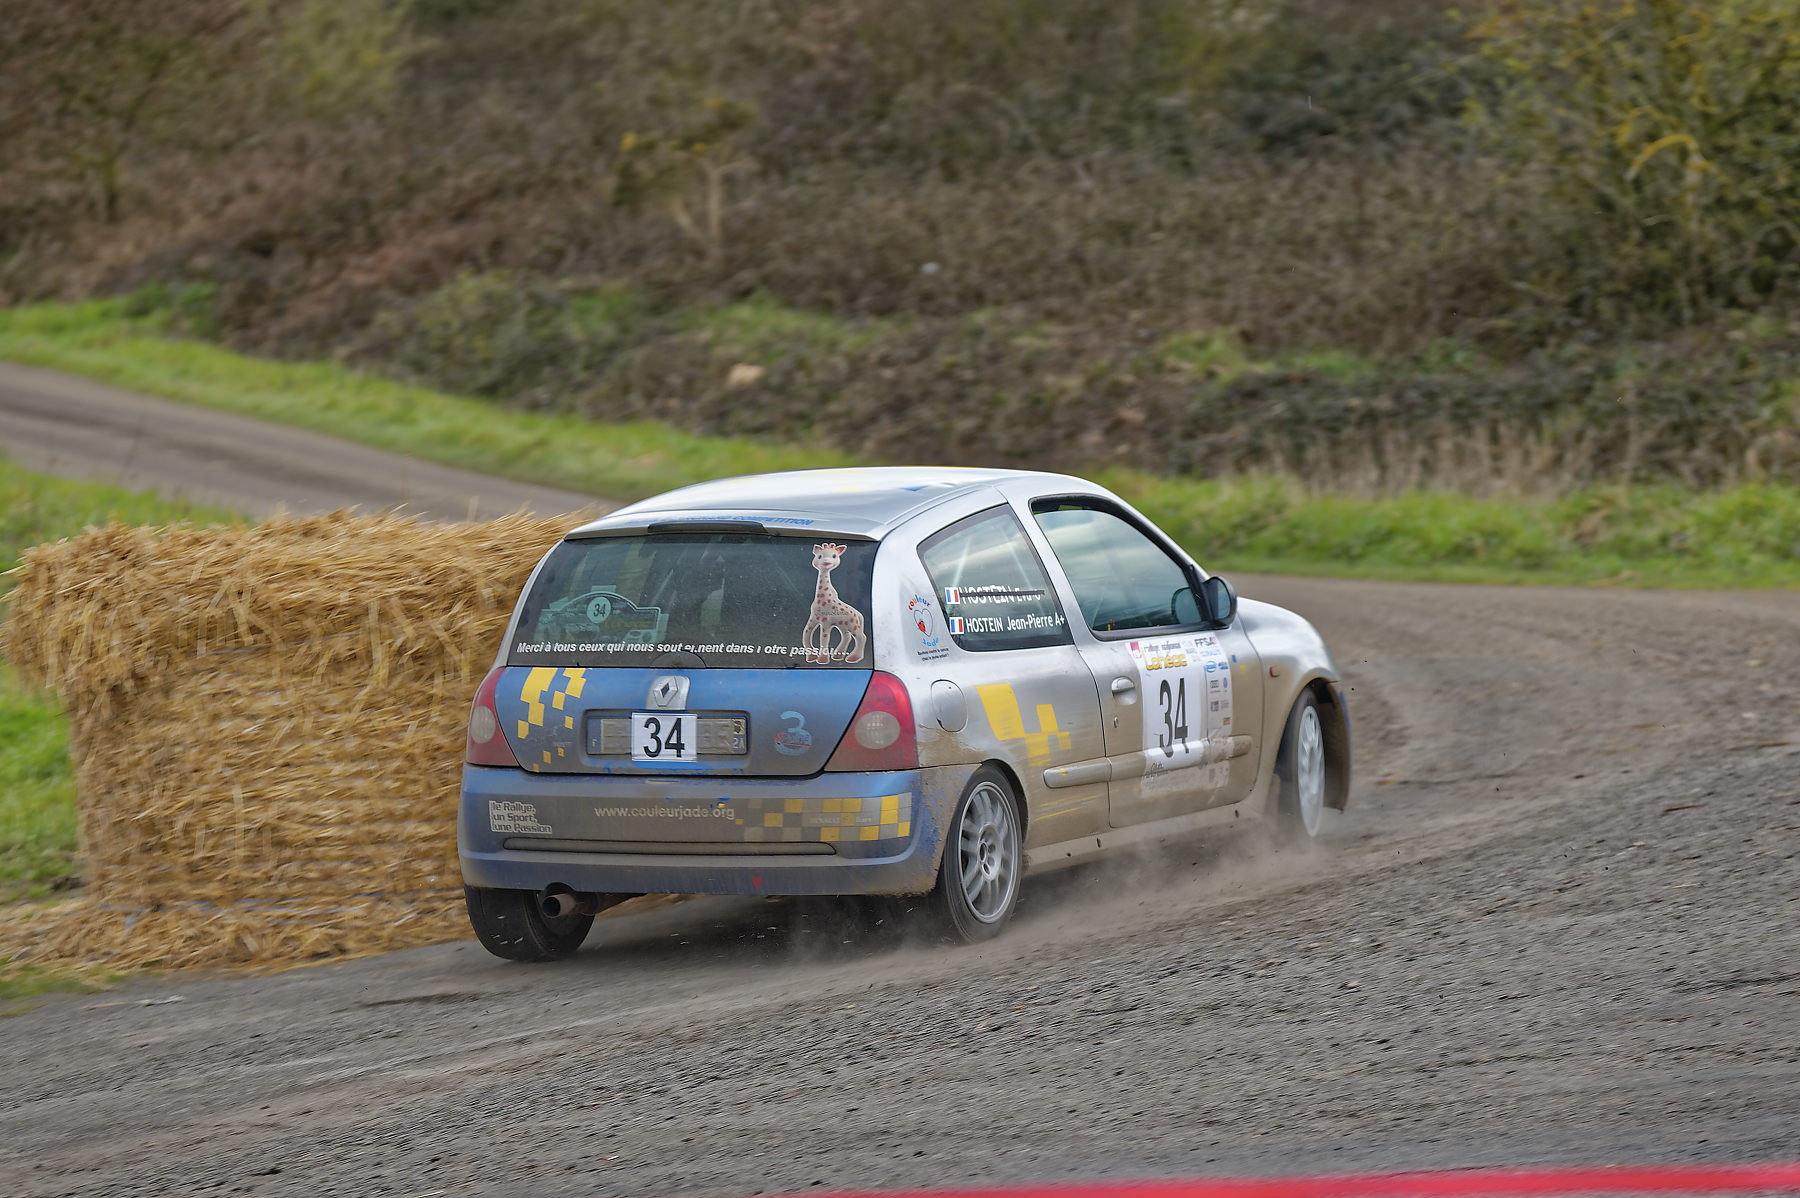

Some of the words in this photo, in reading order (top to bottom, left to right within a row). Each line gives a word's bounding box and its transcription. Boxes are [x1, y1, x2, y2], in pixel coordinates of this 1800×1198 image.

[593, 603, 606, 617] 34
[966, 617, 1004, 633] HOSTEIN
[1007, 613, 1053, 631] Jean-Pierre
[1055, 612, 1065, 626] A+
[516, 641, 544, 653] Merci
[545, 641, 551, 653] à
[553, 642, 576, 653] tous
[579, 642, 604, 652] ceux
[607, 641, 625, 654] qui
[626, 642, 654, 653] nous
[657, 642, 725, 654] soutenent
[726, 642, 754, 654] dans
[1194, 636, 1215, 648] FFSA
[1160, 678, 1189, 758] 34
[643, 717, 686, 758] 34
[492, 802, 501, 811] le
[594, 806, 735, 820] www.couleurjade.org
[493, 824, 512, 832] une
[514, 823, 552, 833] Passion
